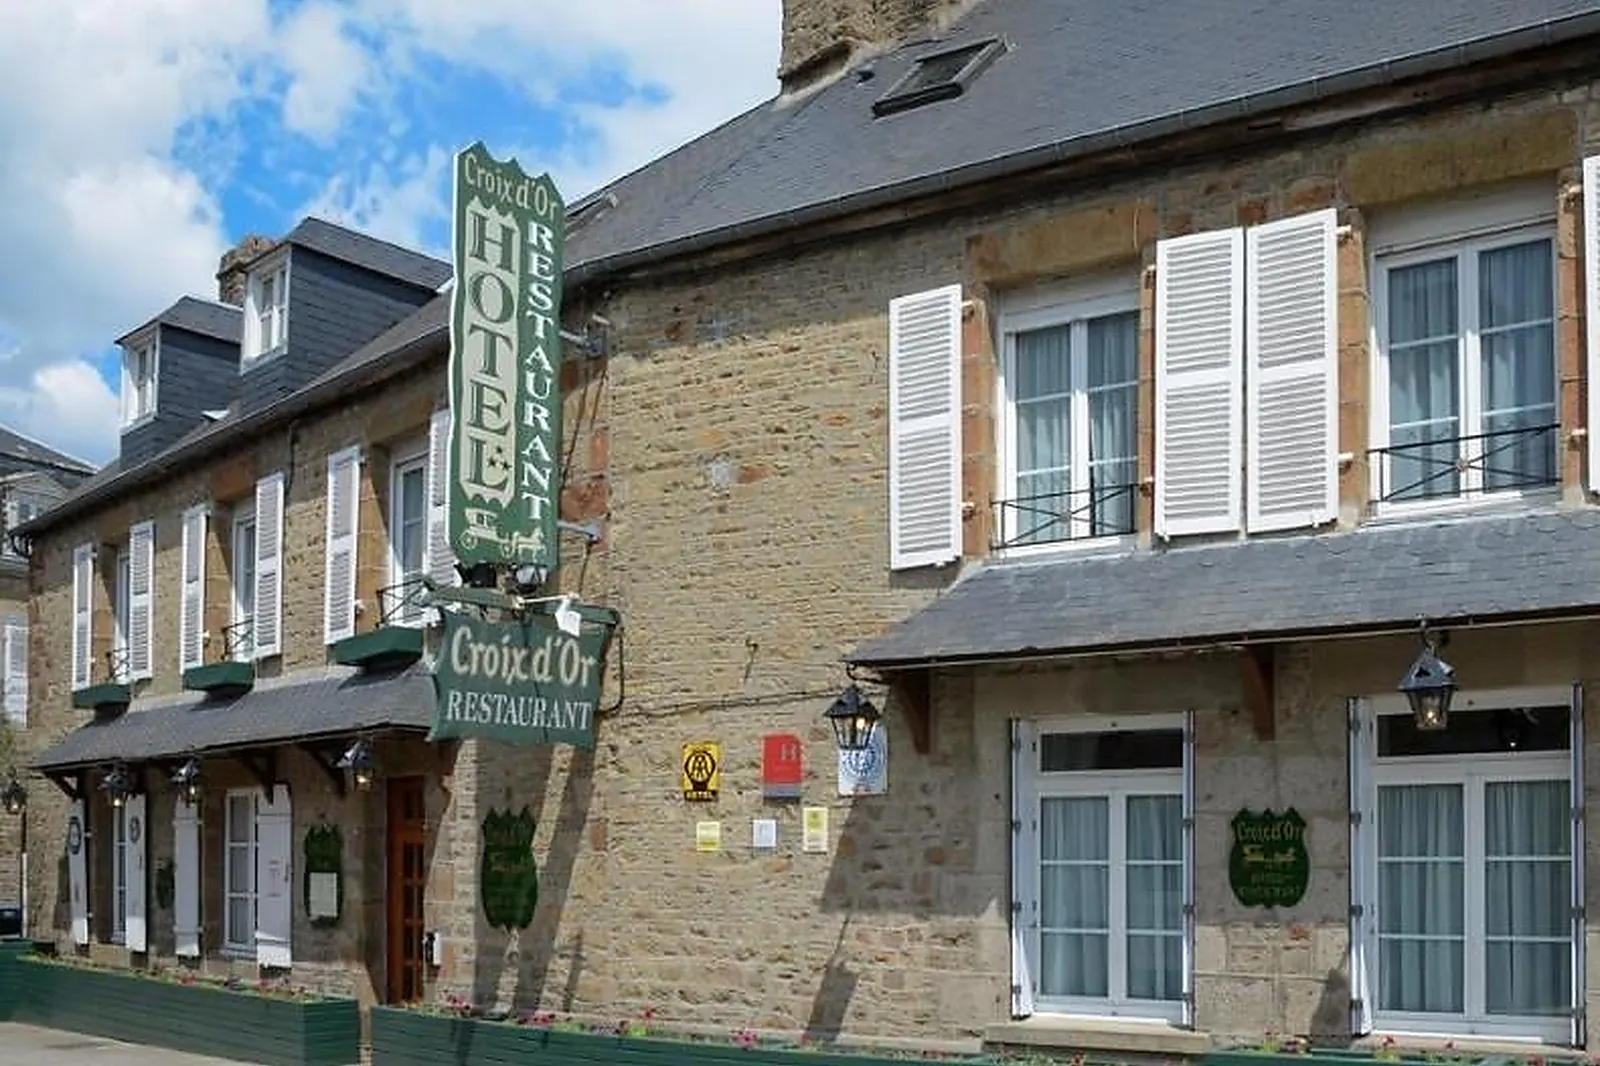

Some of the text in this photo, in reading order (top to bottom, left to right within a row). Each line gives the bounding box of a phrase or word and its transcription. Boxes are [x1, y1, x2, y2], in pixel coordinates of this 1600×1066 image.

[464, 153, 558, 221] Croix d'Or
[467, 210, 515, 492] HOTEL
[521, 221, 555, 521] RESTAURANT
[450, 624, 598, 689] Croix d'Or
[446, 690, 592, 730] RESTAURANT
